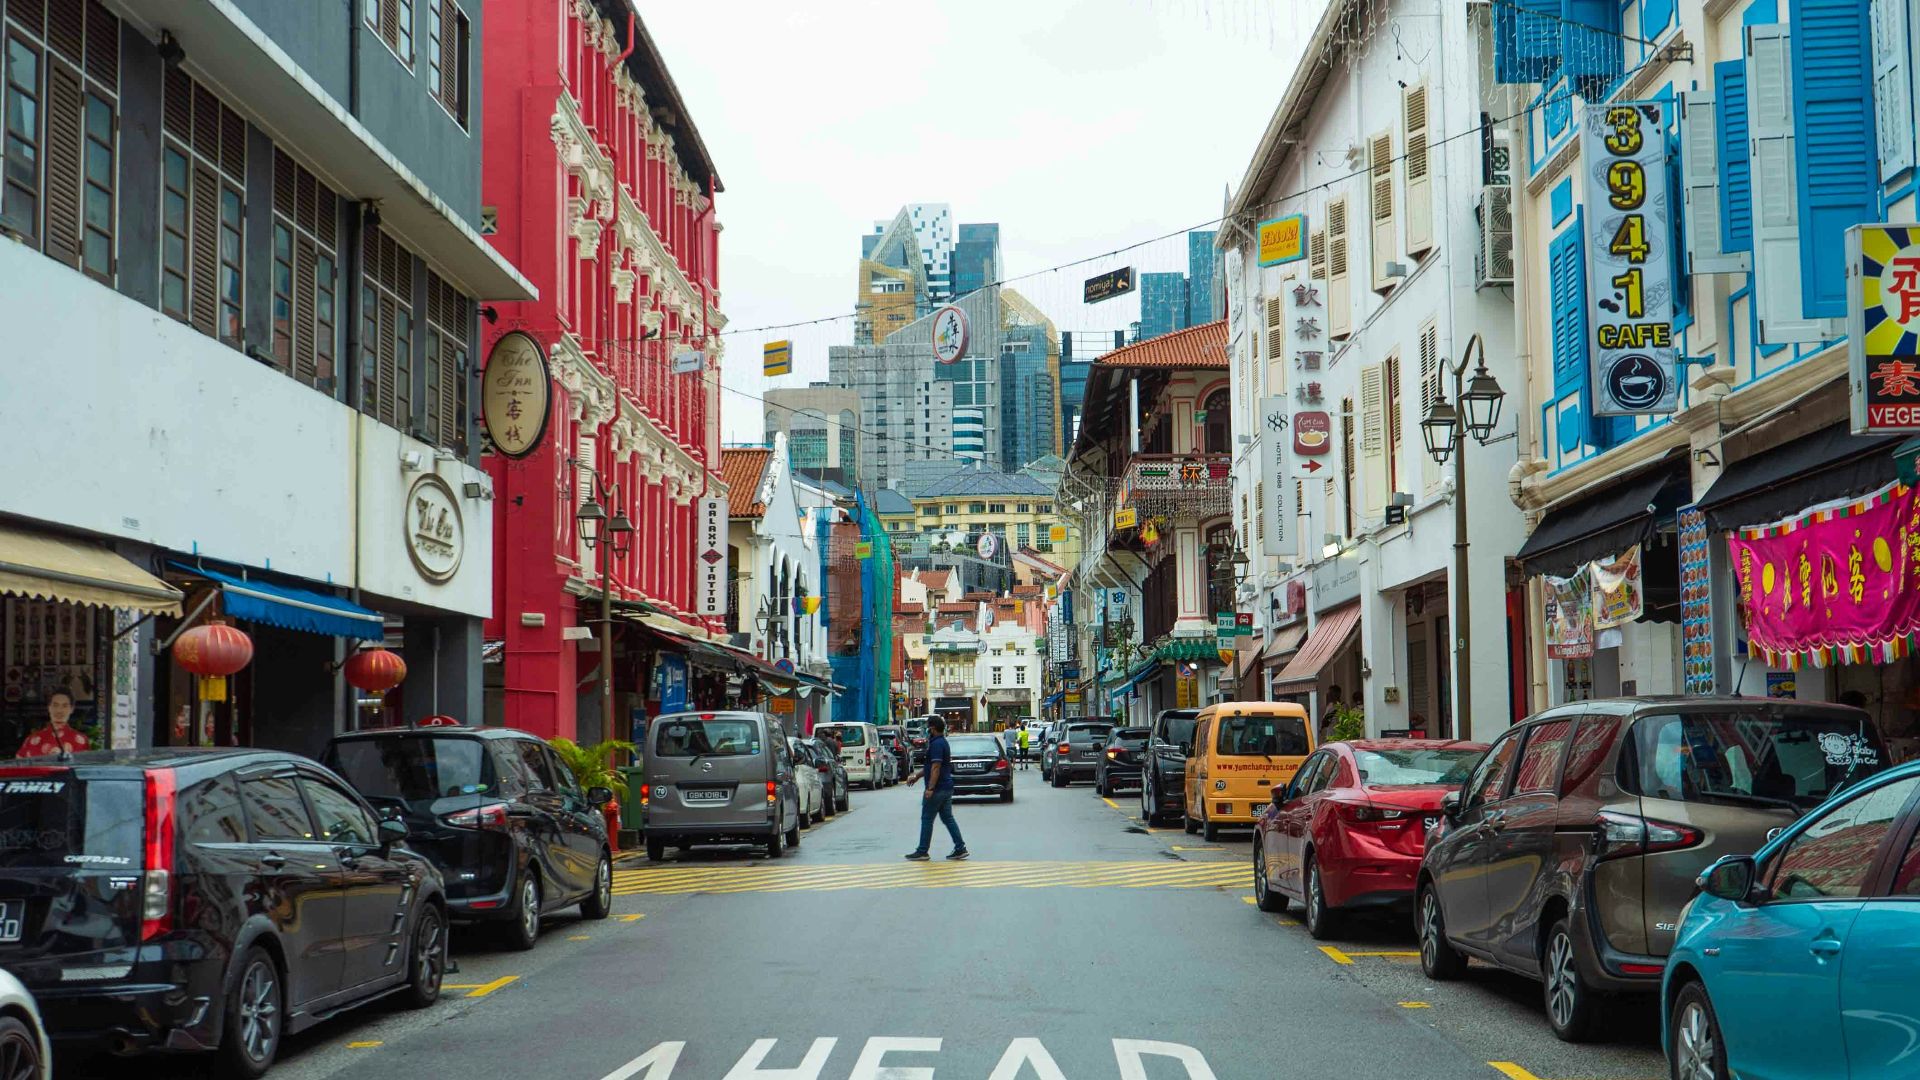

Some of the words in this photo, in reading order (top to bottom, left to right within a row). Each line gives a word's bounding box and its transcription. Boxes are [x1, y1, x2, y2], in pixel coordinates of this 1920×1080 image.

[1604, 107, 1650, 319] 3941
[1293, 283, 1325, 405] 飲茶酒樓
[1598, 323, 1671, 350] CAFE
[499, 348, 532, 367] The
[496, 369, 532, 387] Inn
[708, 502, 717, 548] GALAXY
[707, 566, 716, 612] TATTOO
[1458, 638, 1464, 649] 9
[1852, 745, 1877, 758] Baby
[1864, 757, 1878, 765] Car
[1655, 922, 1677, 931] SIE
